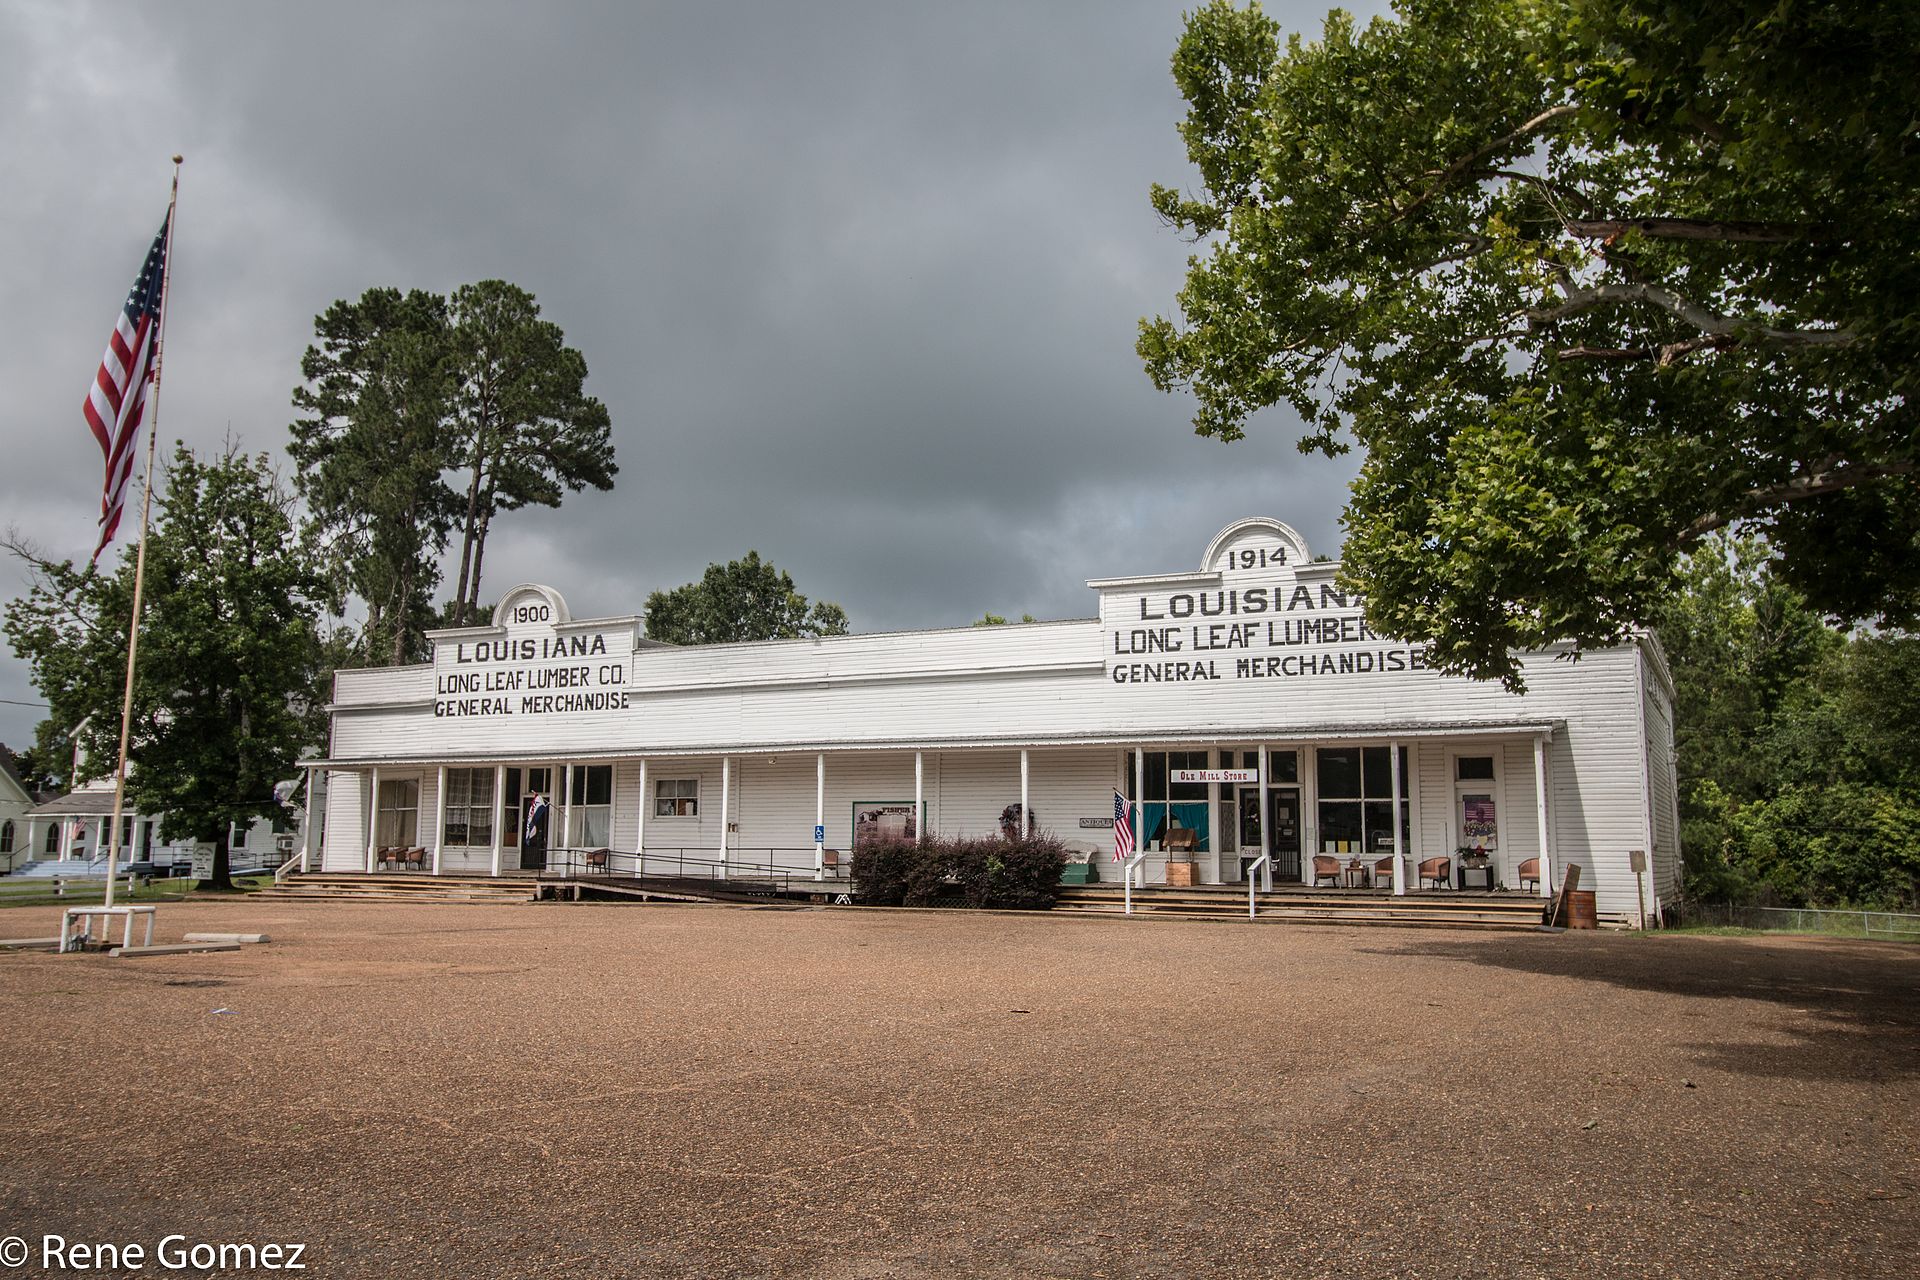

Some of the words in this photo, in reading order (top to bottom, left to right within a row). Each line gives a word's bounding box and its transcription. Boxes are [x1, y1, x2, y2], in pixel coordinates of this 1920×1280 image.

[1229, 546, 1288, 571] 1914
[513, 605, 549, 624] 1900
[457, 634, 607, 664] LOUISIANA
[1114, 627, 1183, 654] LONG
[1193, 622, 1260, 650] LEAF
[438, 673, 480, 695] LONG
[485, 670, 524, 692] LEAF
[527, 666, 589, 689] LUMBER
[599, 664, 626, 686] CO.
[1112, 660, 1221, 684] GENERAL
[1236, 649, 1426, 679] MERCHANDISE
[434, 697, 513, 717] GENERAL
[521, 691, 629, 714] MERCHANDISE
